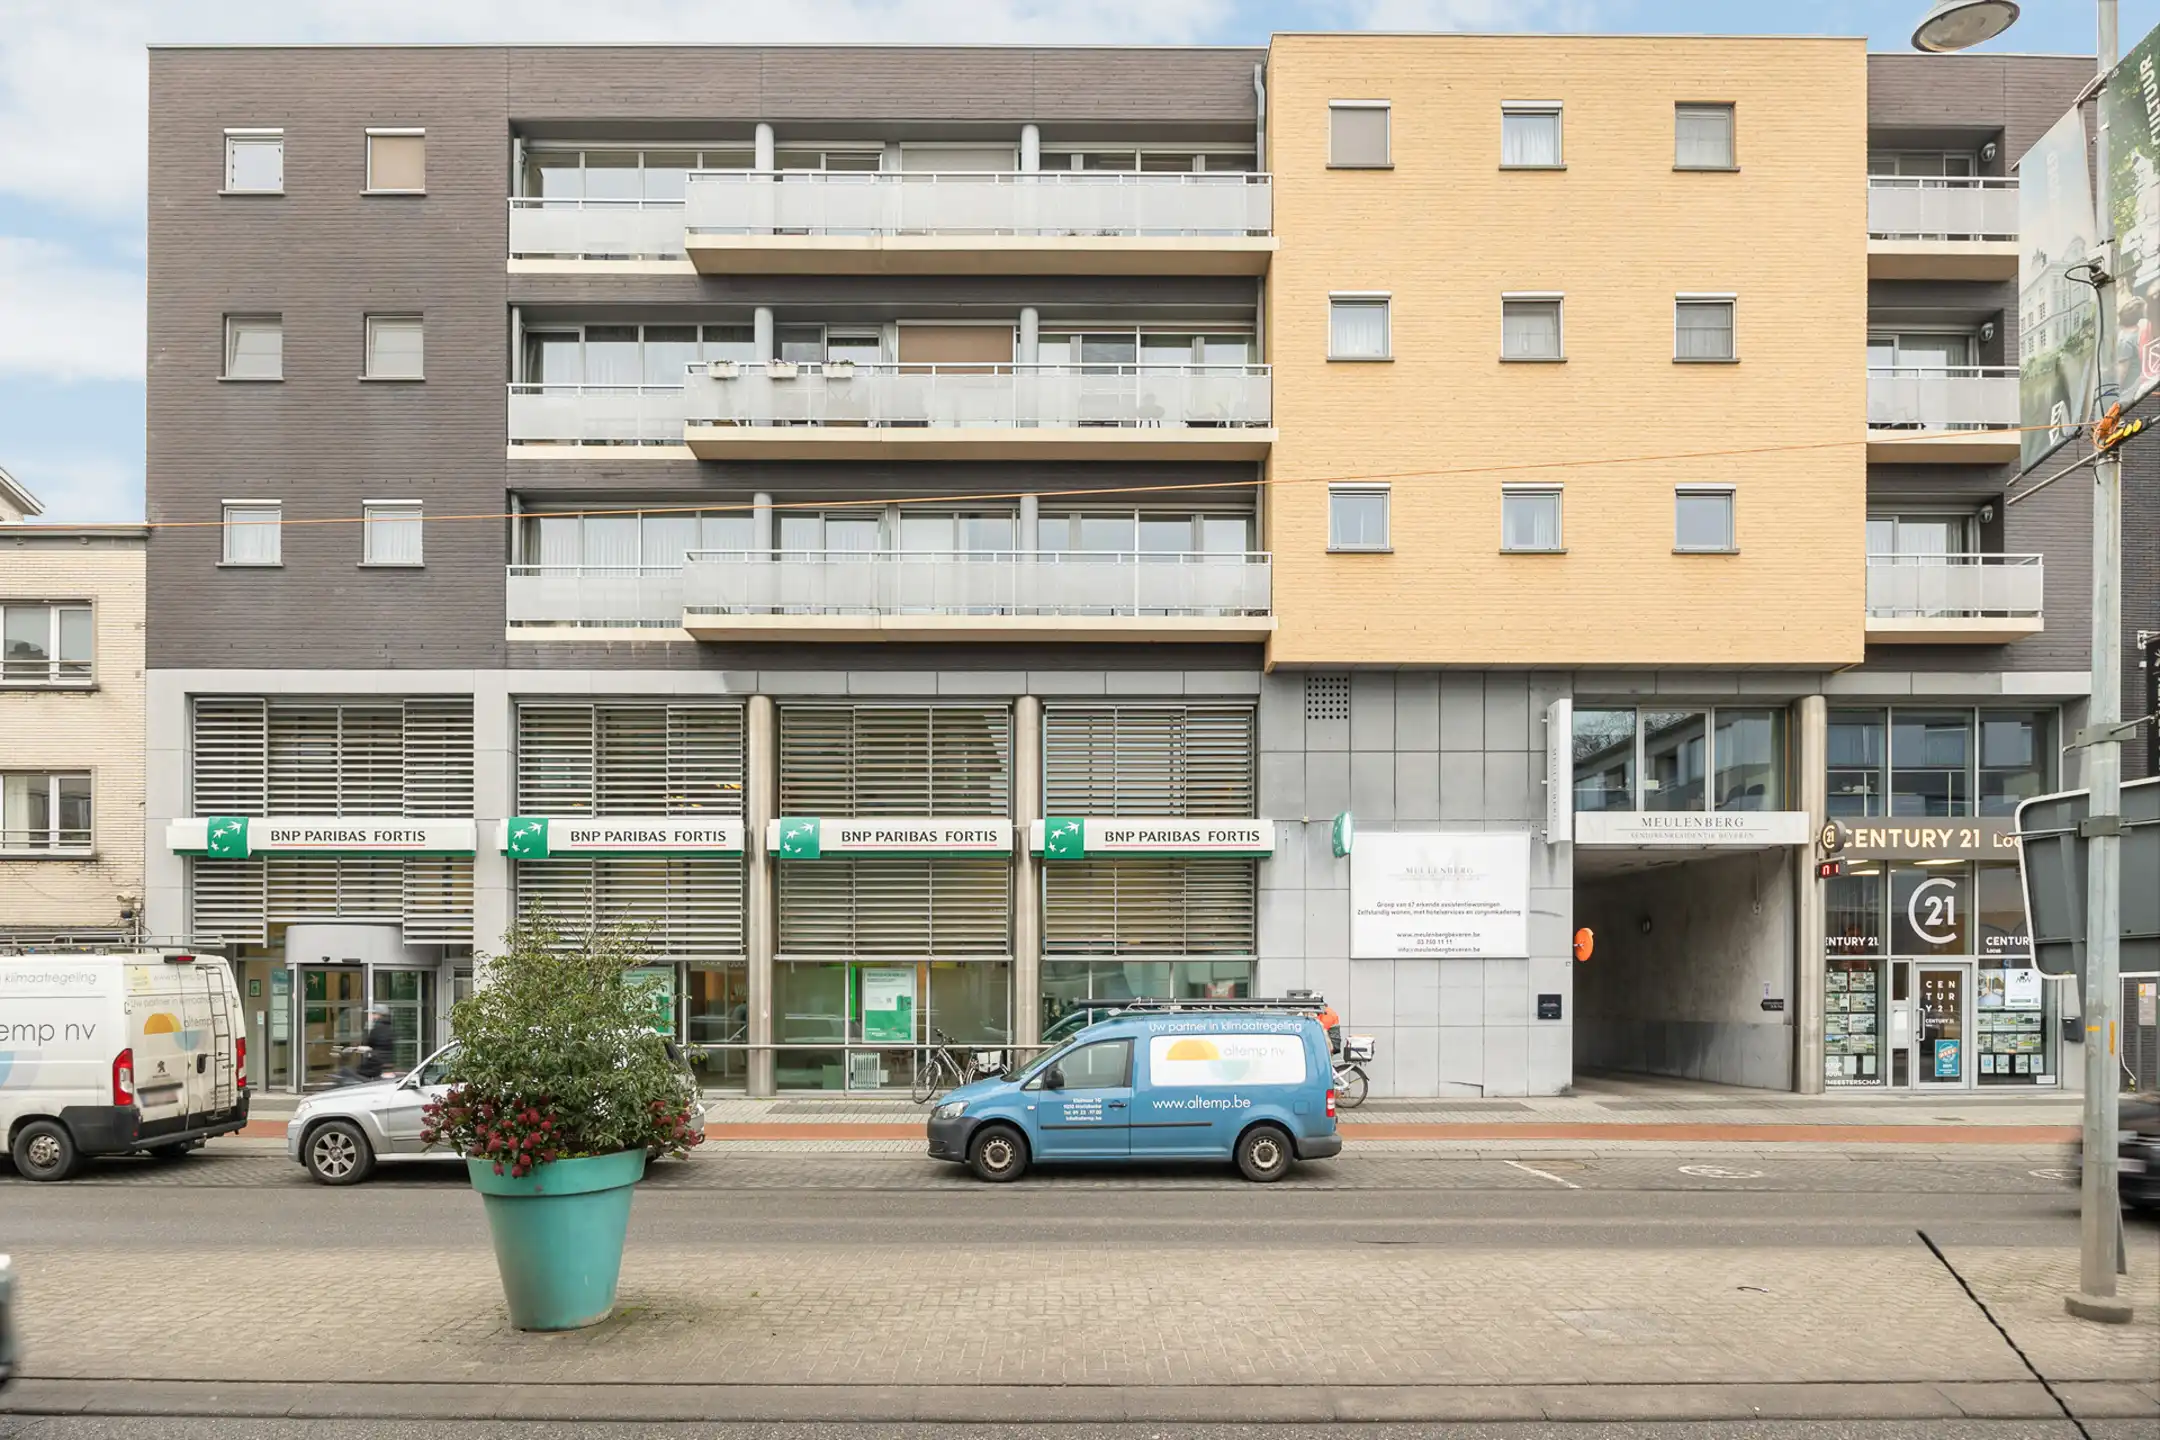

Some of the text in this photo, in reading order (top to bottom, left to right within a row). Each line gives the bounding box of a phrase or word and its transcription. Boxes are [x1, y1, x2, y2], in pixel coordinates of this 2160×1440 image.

[1641, 817, 1744, 828] MEULENBERG
[271, 830, 426, 842] BNP PARIBAS FORTIS
[571, 830, 726, 842] BNP PARIBAS FORTIS
[842, 830, 997, 842] BNP PARIBAS FORTIS
[1105, 830, 1260, 842] BNP PARIBAS FORTIS
[1960, 828, 1980, 848] 21
[1376, 901, 1395, 909] Groep
[1396, 901, 1407, 909] van
[5, 972, 97, 985] klimaatregeling
[65, 1024, 96, 1040] nv
[1150, 1021, 1302, 1032] Uw partner in klimaatregeling
[1224, 1044, 1285, 1059] altemp nv
[1152, 1095, 1251, 1110] www.altemp.be
